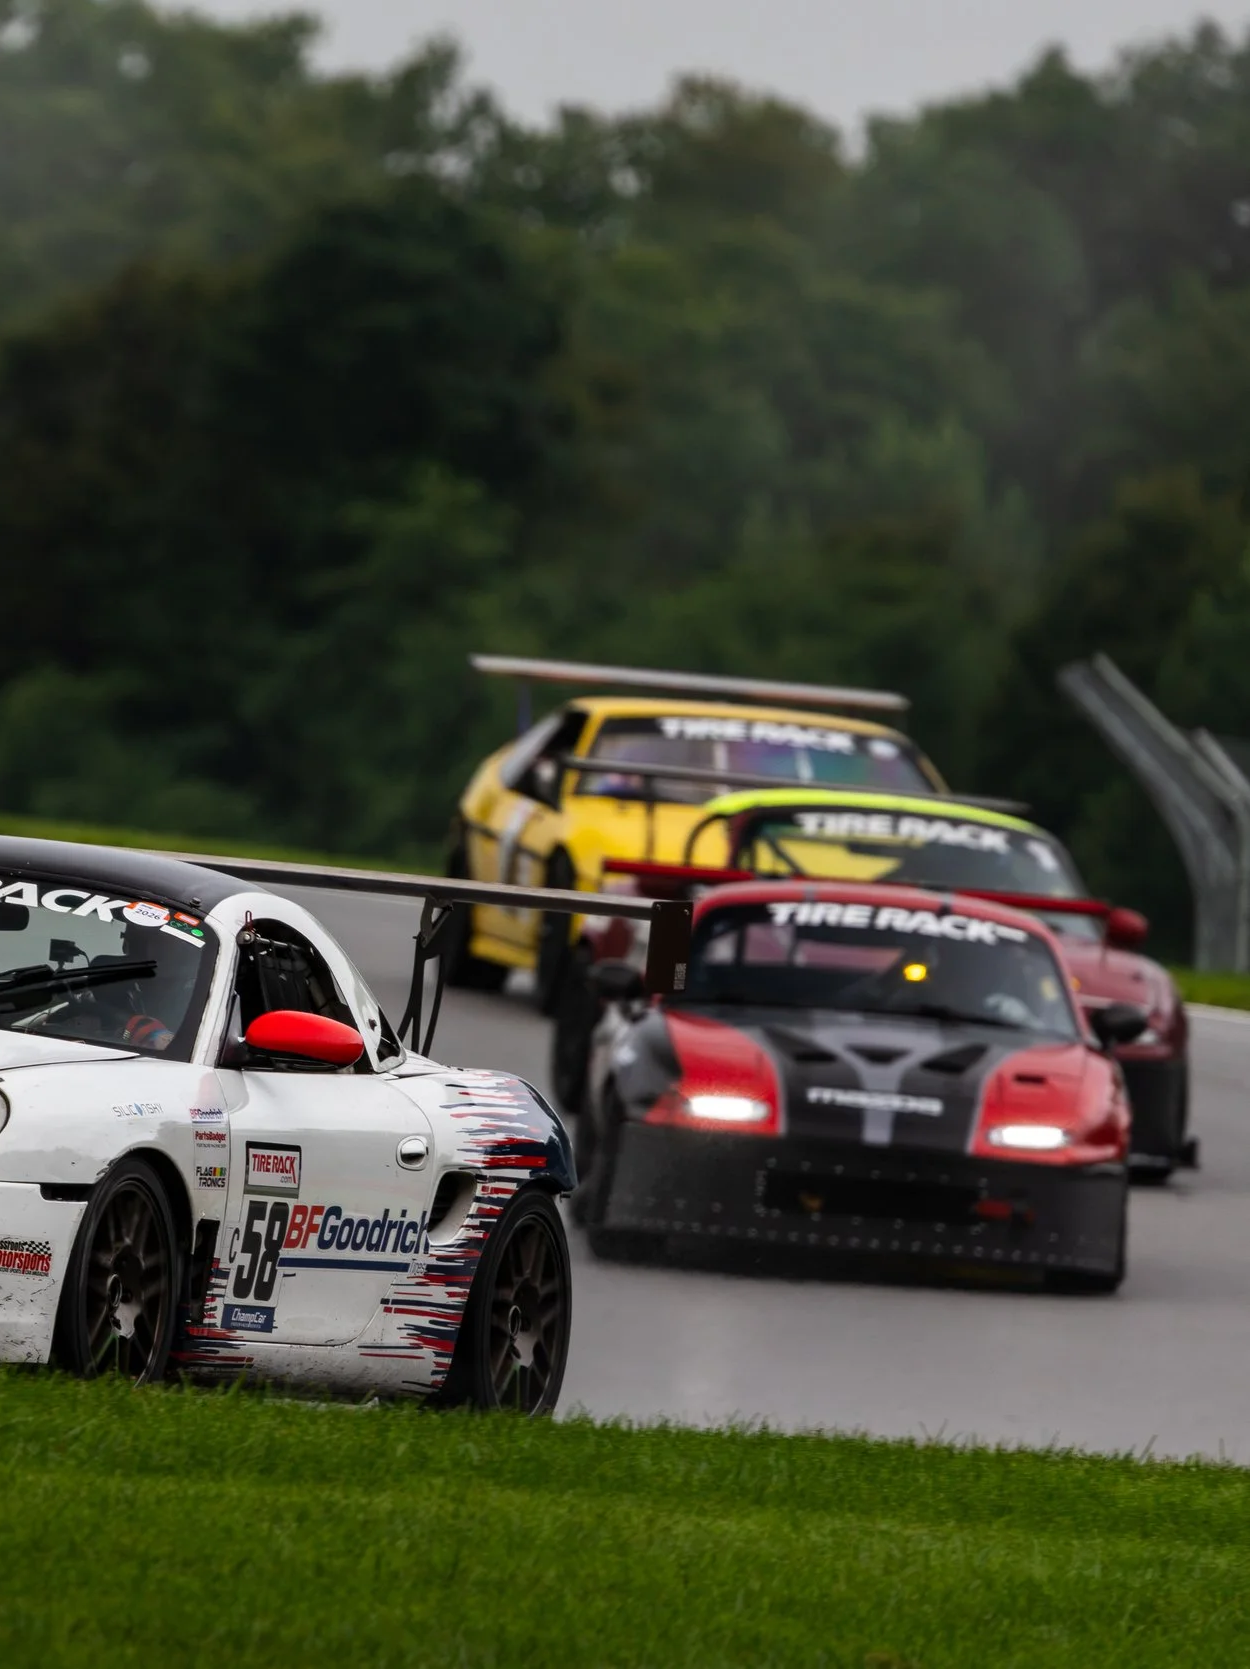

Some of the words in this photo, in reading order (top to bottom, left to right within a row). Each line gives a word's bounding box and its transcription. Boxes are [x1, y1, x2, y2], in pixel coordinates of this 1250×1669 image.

[658, 718, 748, 741] TIRE
[751, 721, 855, 755] RACK
[795, 812, 893, 836] TIRE
[898, 817, 1010, 853] RACK
[135, 908, 162, 921] 2026
[767, 902, 874, 928] TIRE
[875, 907, 998, 945] RACK
[195, 1131, 227, 1143] PartsBadger
[196, 1167, 213, 1177] FLAG
[252, 1153, 273, 1173] TIRE
[271, 1155, 297, 1184] RACK
[279, 1175, 293, 1184] .com
[199, 1178, 226, 1188] TRONICS
[283, 1204, 431, 1255] BFGoodrich
[232, 1200, 290, 1302] 58
[231, 1307, 268, 1326] ChampCar
